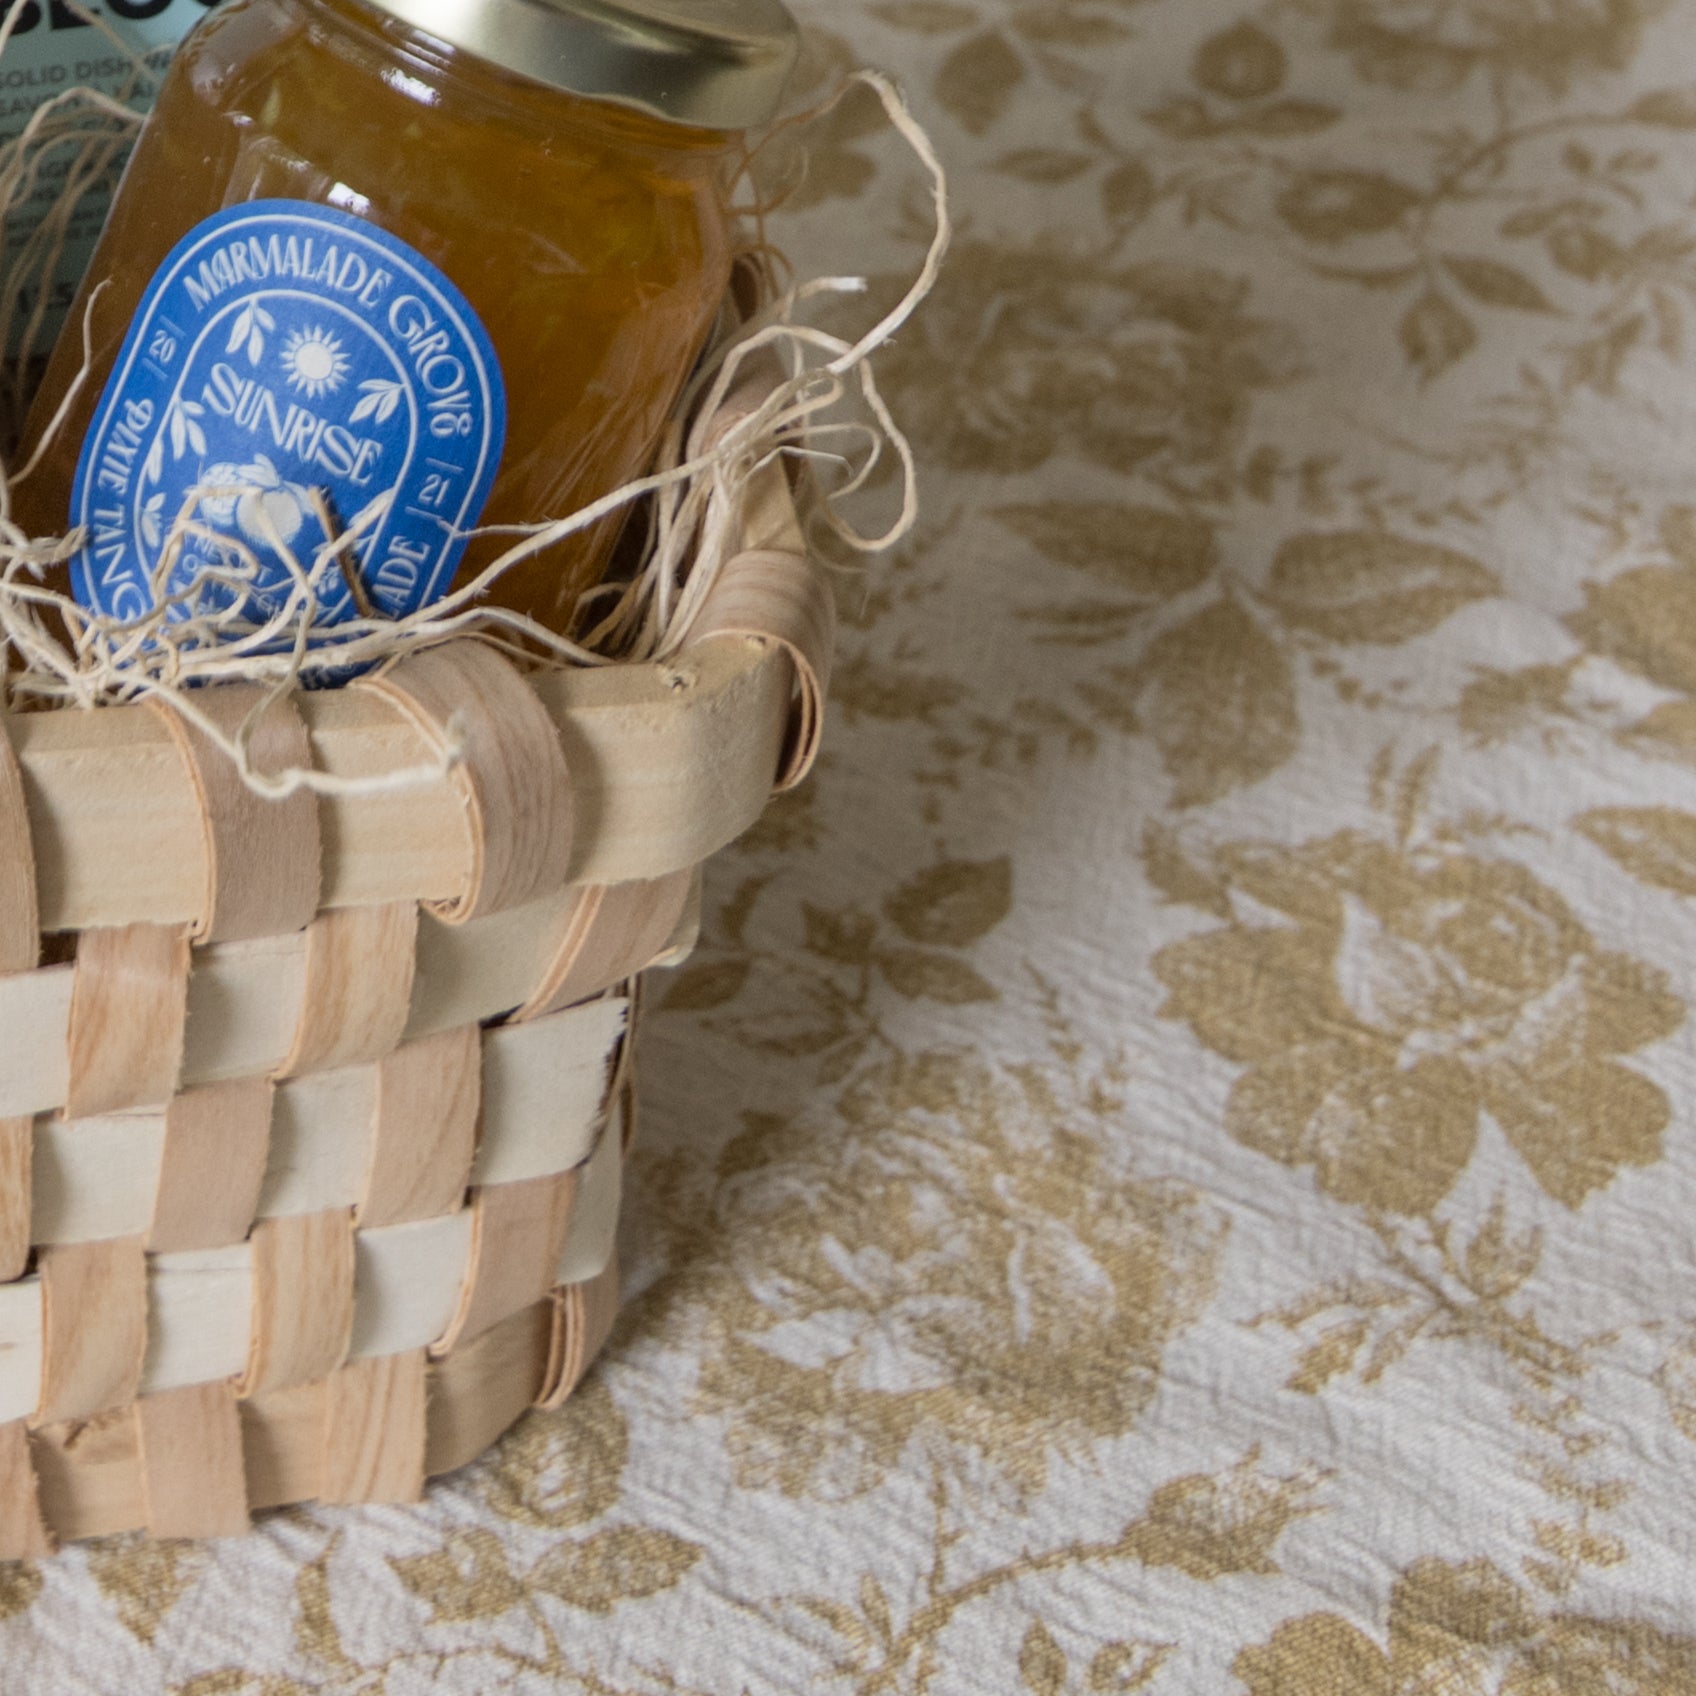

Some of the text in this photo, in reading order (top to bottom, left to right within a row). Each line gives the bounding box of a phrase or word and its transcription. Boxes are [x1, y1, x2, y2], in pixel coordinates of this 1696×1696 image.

[183, 233, 394, 311] MARMALADE
[388, 293, 473, 440] GROVE
[97, 397, 154, 496] PIXIE
[203, 362, 384, 487] SUNRISE
[418, 472, 451, 508] 21
